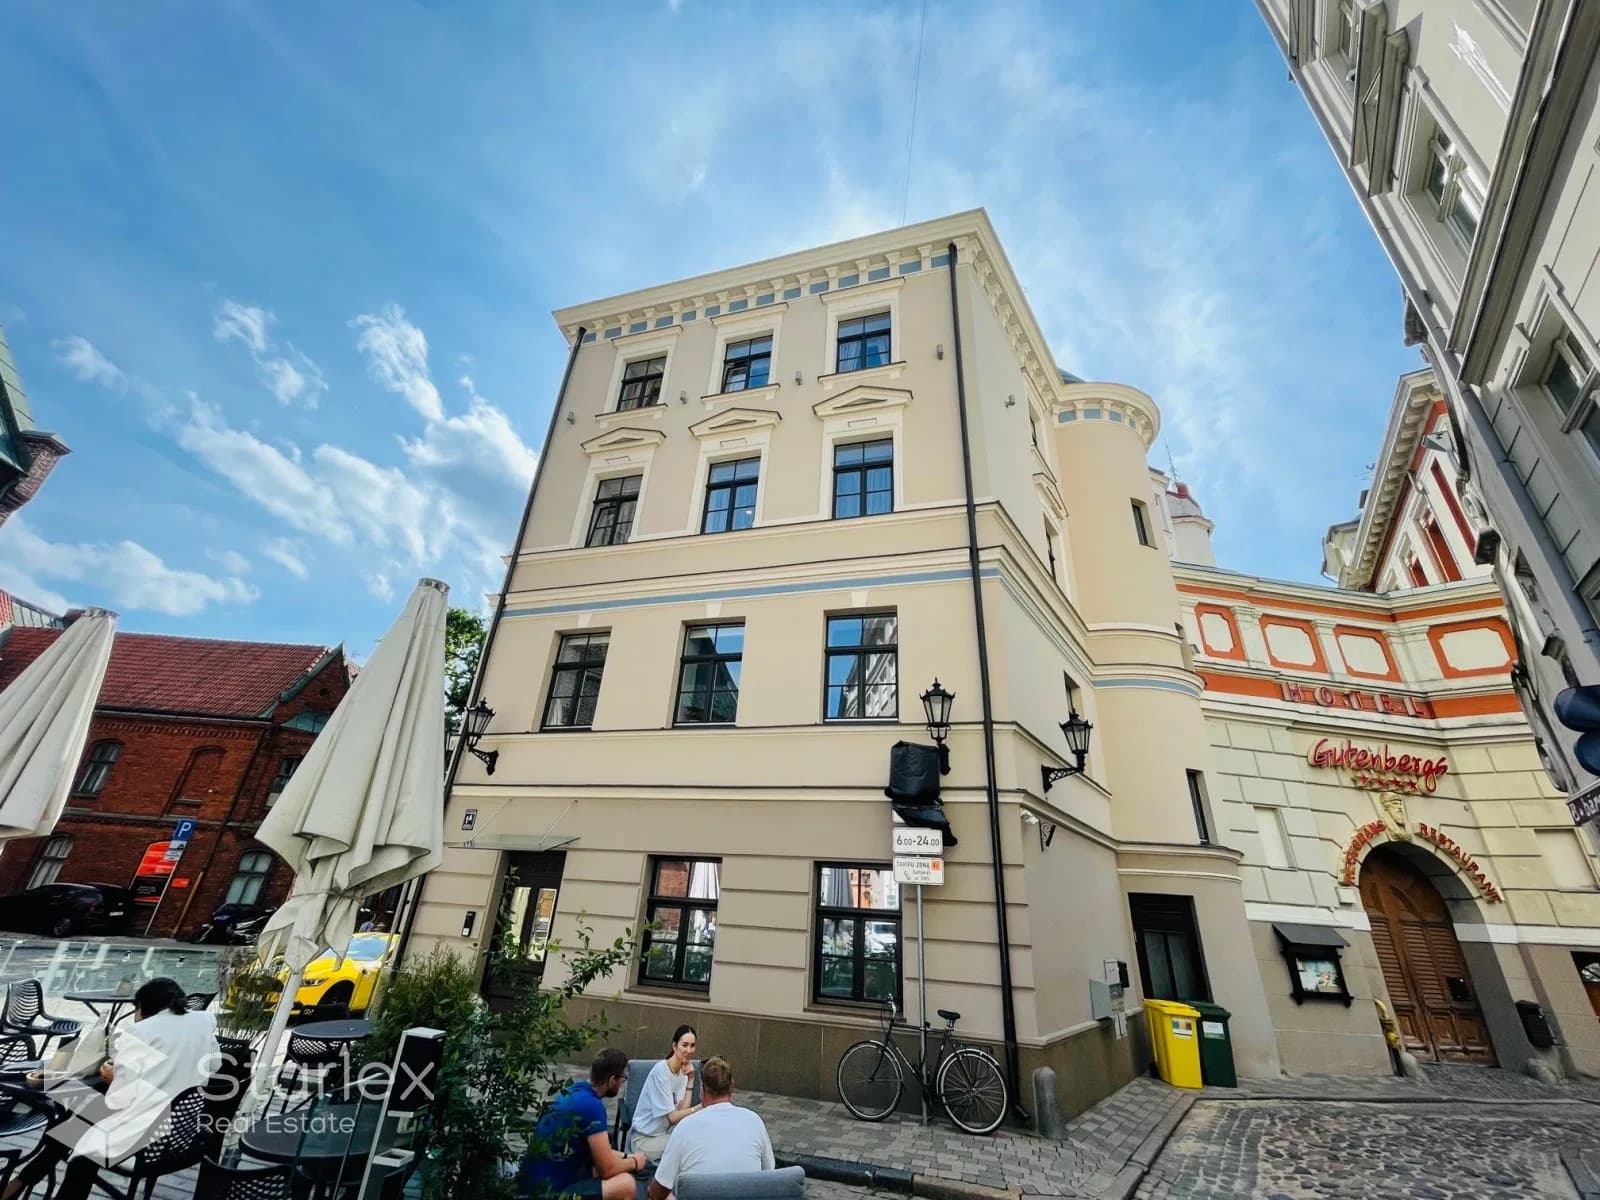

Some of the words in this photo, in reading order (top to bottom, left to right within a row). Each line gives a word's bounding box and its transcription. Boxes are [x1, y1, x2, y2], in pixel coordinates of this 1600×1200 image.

[1280, 682, 1424, 717] HOTEL
[1308, 738, 1449, 794] Gutenbergs
[178, 821, 192, 838] P
[1416, 821, 1503, 904] RESTAURANT
